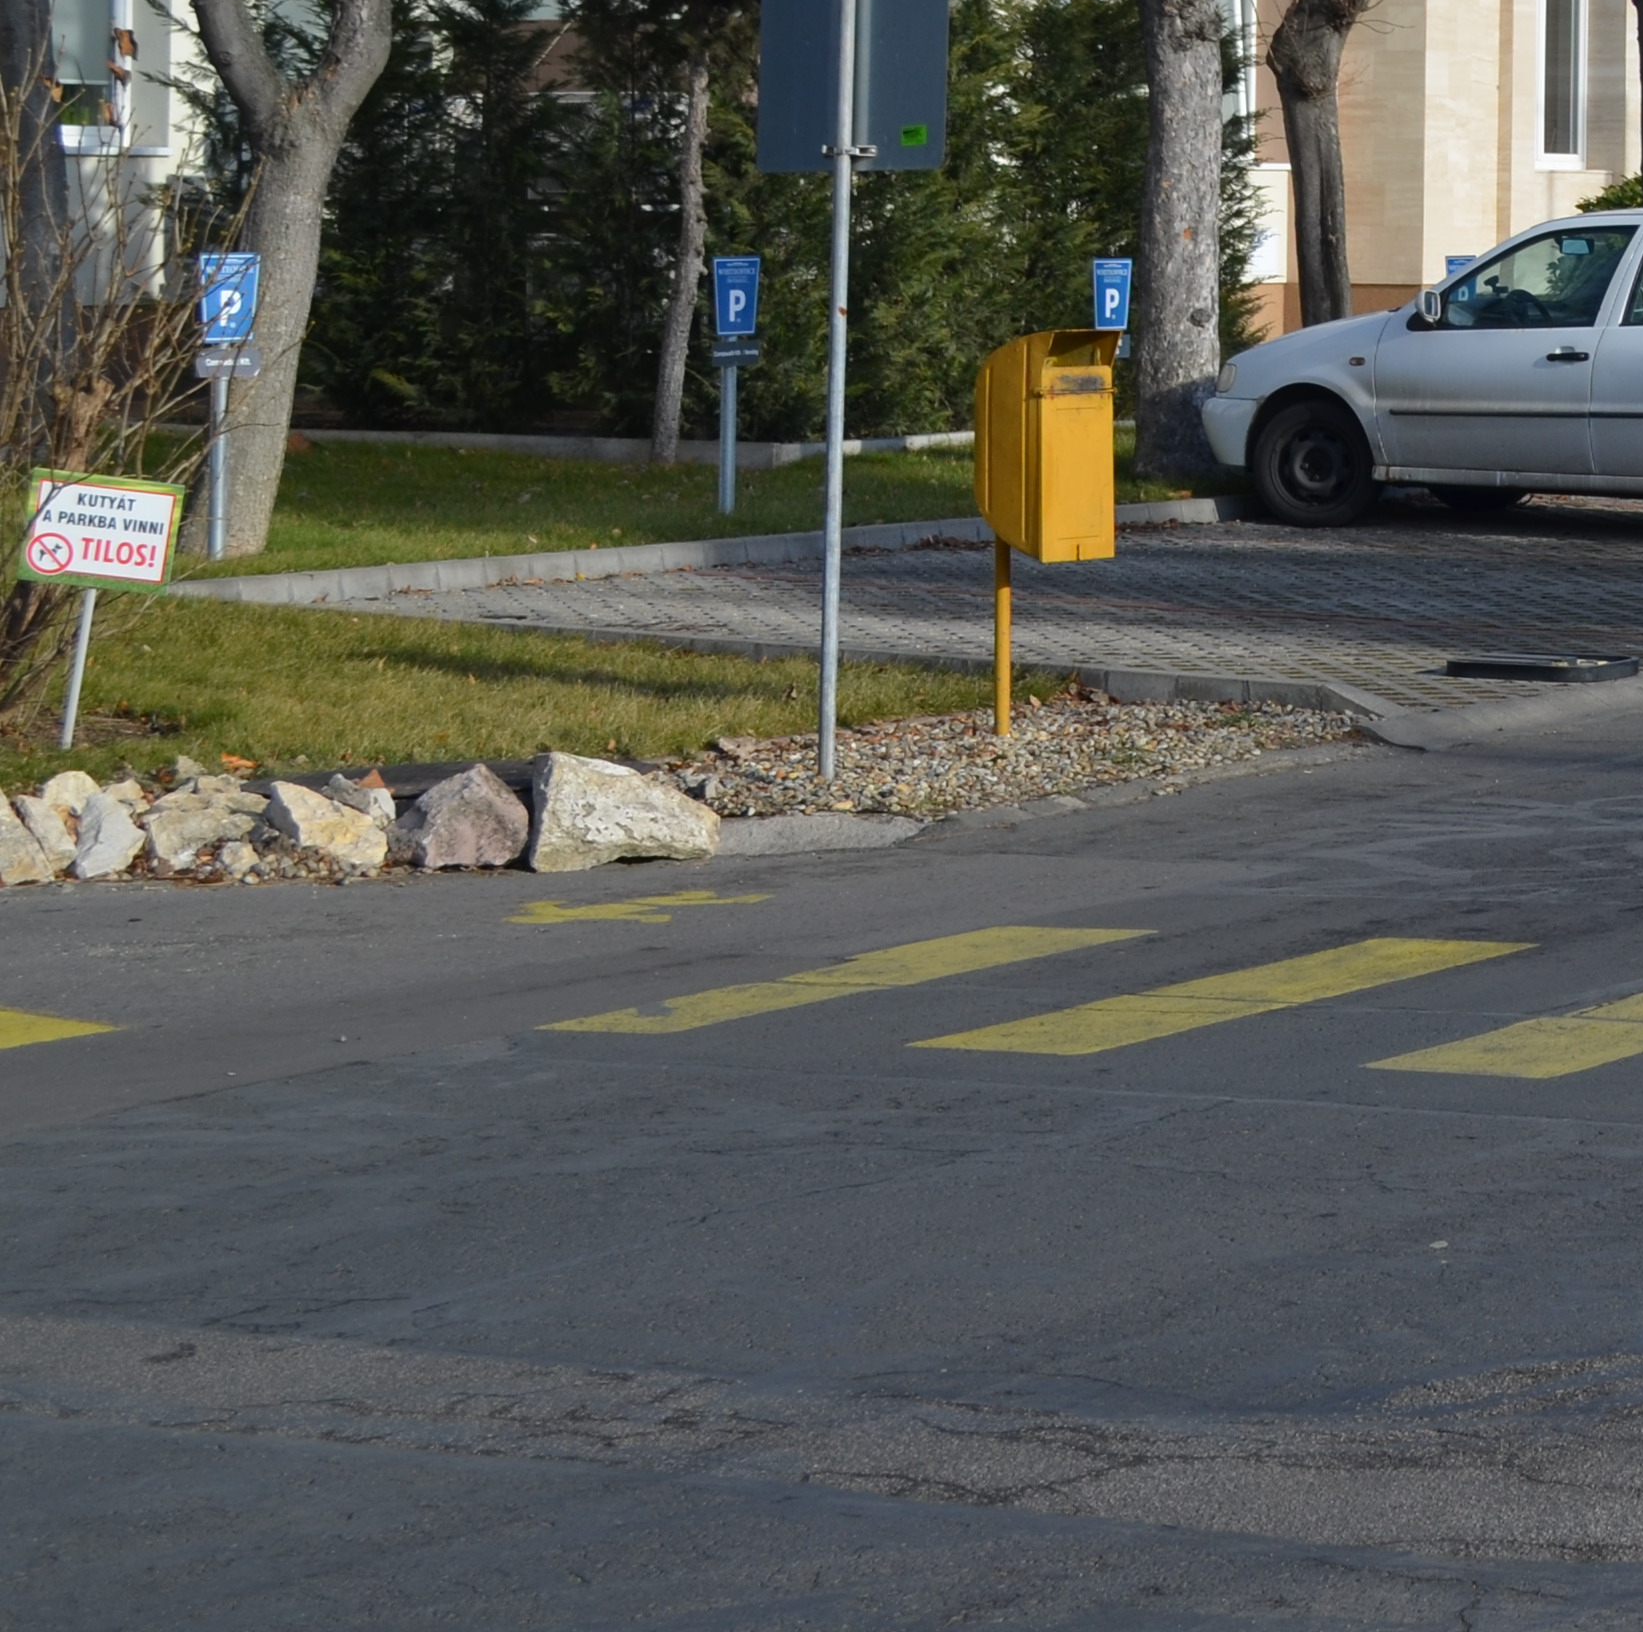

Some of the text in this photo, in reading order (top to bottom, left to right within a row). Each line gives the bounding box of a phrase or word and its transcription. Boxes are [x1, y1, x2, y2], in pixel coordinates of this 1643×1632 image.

[729, 289, 747, 322] P
[1105, 288, 1120, 319] P
[77, 492, 137, 512] KUTYÁT
[42, 509, 164, 536] A PARKBA VINNI
[81, 537, 157, 568] TILOS!
